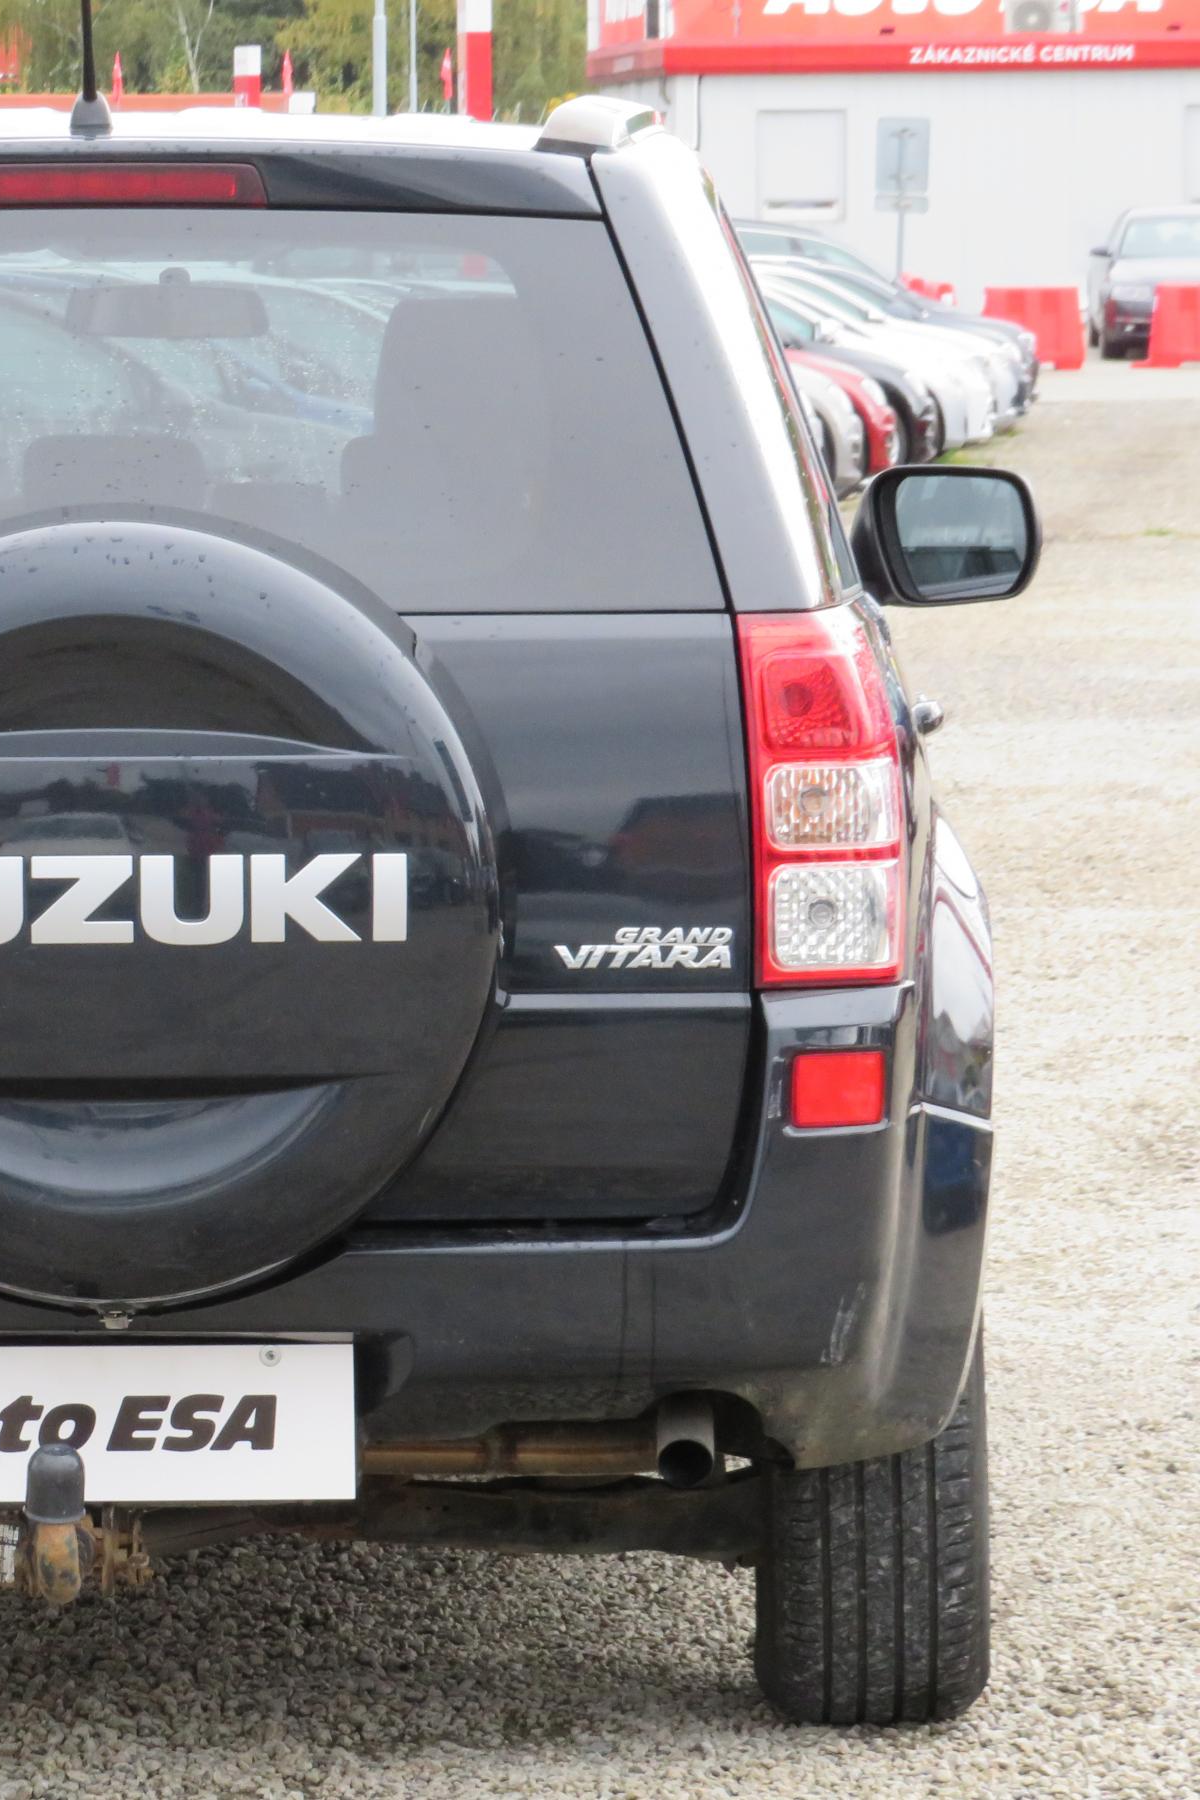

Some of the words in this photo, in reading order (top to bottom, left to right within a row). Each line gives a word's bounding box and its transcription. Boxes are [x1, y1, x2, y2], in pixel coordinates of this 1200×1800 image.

[909, 44, 1036, 64] ZÁKAZNICKÉ
[1039, 44, 1134, 63] CENTRUM
[614, 926, 734, 945] GRAND
[553, 943, 733, 970] VITARA
[106, 1394, 277, 1452] ESA
